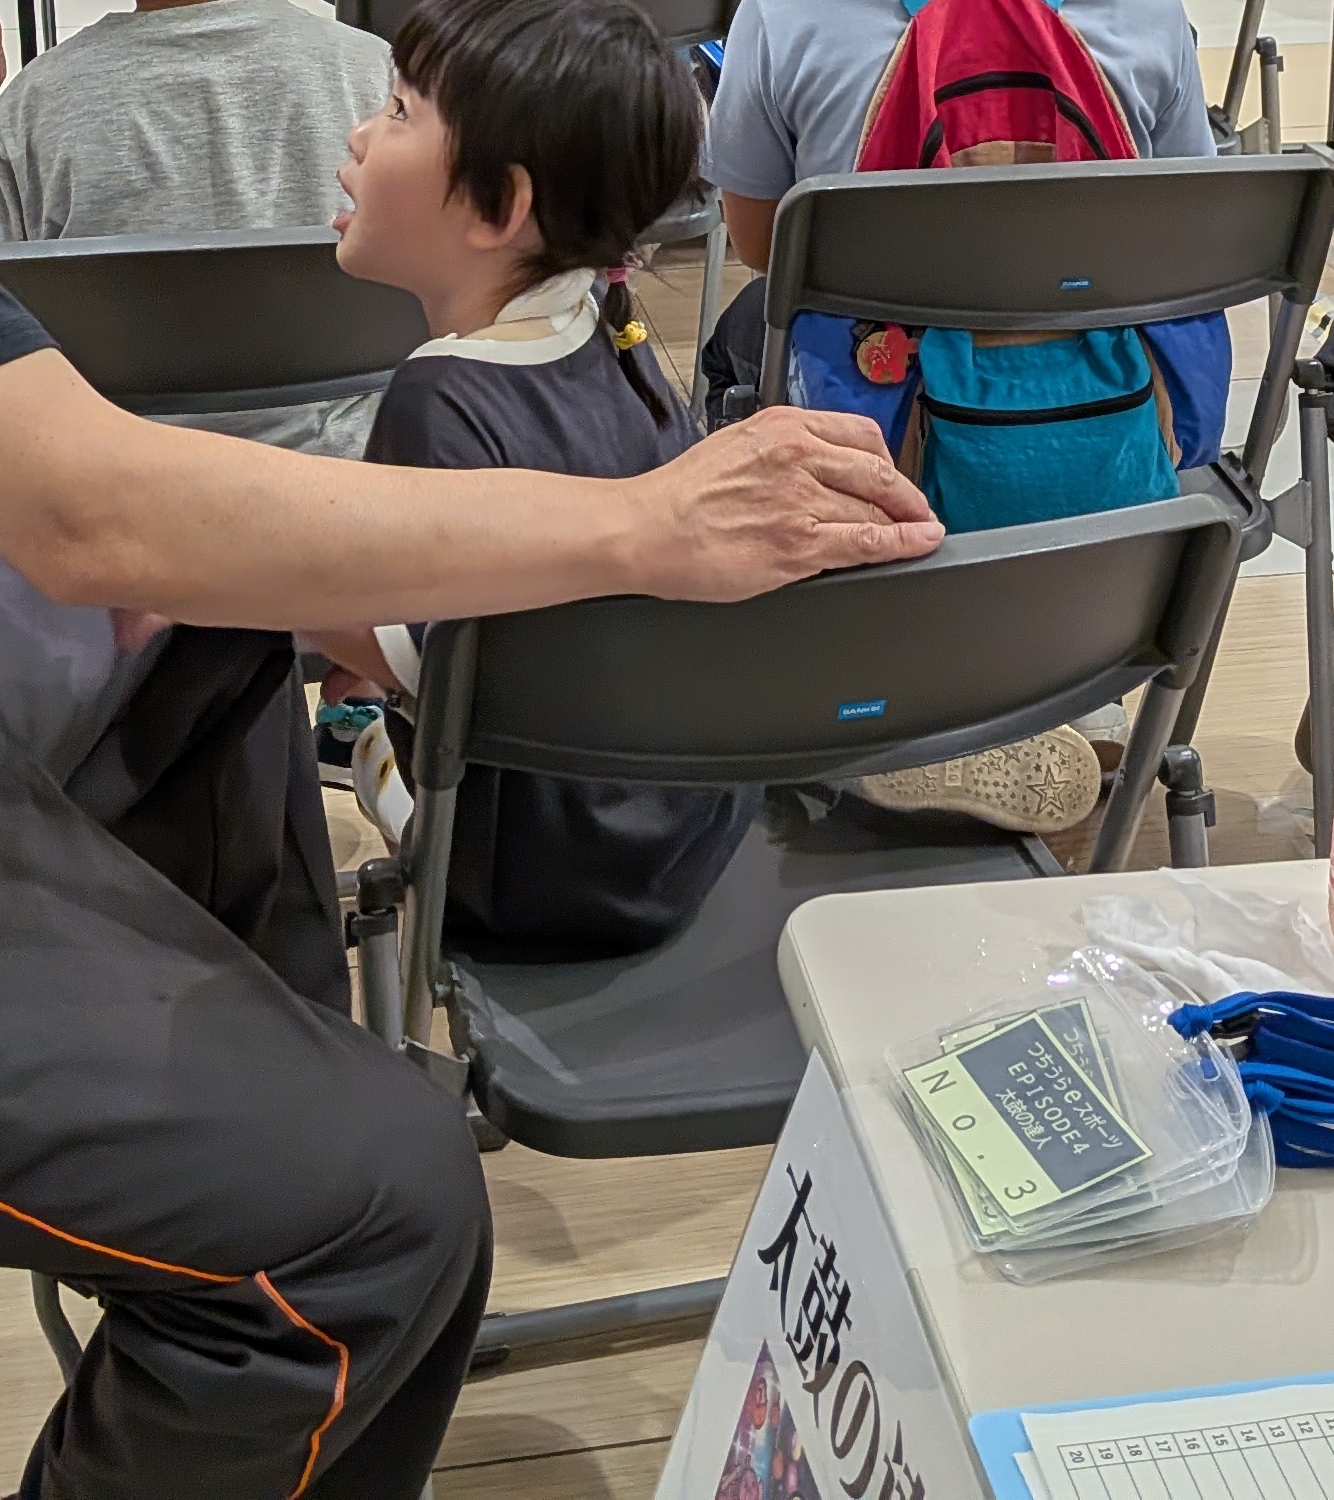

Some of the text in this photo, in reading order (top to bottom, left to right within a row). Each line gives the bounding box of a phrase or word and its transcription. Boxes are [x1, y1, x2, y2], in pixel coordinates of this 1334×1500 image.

[1028, 1041, 1123, 1150] つちうらeスポーツ
[995, 1088, 1053, 1150] 太鼓の達人
[1268, 1425, 1285, 1438] 13
[1296, 1420, 1314, 1434] 12
[1183, 1436, 1200, 1450] 16
[1211, 1433, 1229, 1447] 15
[1240, 1429, 1257, 1443] 14
[1097, 1447, 1115, 1460] 19
[1126, 1443, 1143, 1457] 18
[1154, 1440, 1172, 1454] 17
[1069, 1450, 1085, 1464] 20
